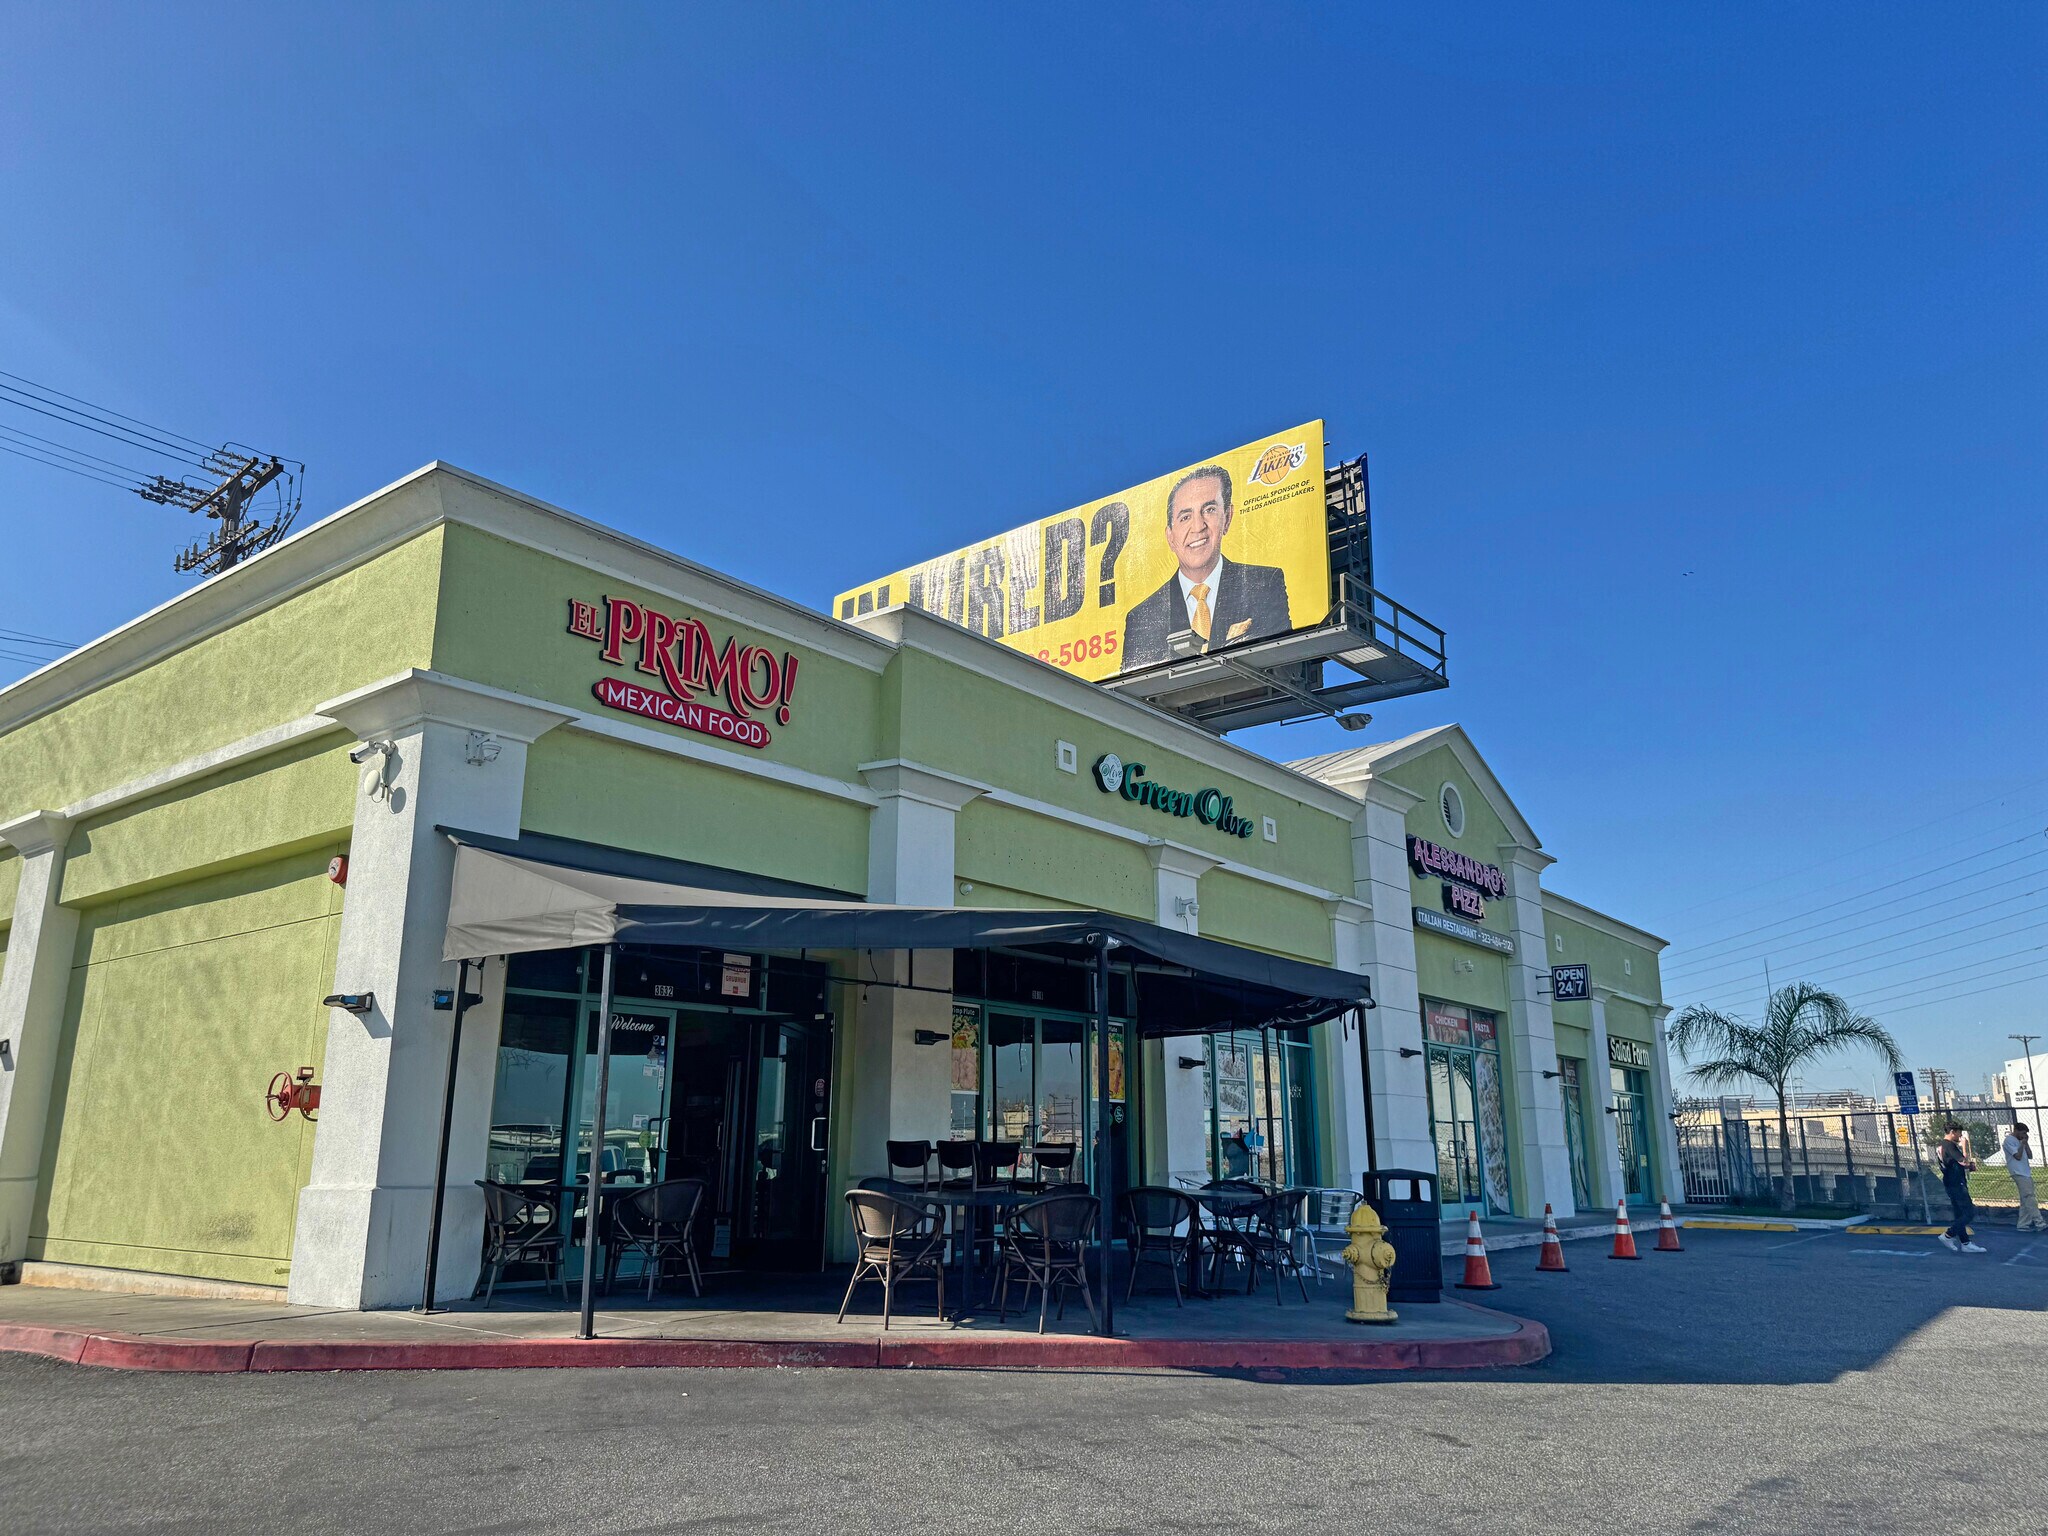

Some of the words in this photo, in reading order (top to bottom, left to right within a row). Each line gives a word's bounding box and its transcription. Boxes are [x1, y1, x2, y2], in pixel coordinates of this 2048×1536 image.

[1251, 450, 1303, 482] LAKERS
[1239, 507, 1250, 515] THE
[1251, 503, 1263, 511] LOS
[1263, 493, 1291, 507] ANGELES
[1291, 486, 1315, 498] LAKERS
[1243, 494, 1270, 506] OFFICIAL
[1270, 483, 1300, 498] SPONSOR
[1301, 479, 1311, 487] OF
[567, 598, 604, 641] EL
[600, 594, 800, 726] PRIMO!
[607, 681, 703, 728] MEXICAN
[708, 712, 763, 744] FOOD
[1122, 761, 1194, 818] Green
[1196, 788, 1255, 838] Olive
[1413, 837, 1508, 896] ALESSANDRO'S
[1451, 885, 1486, 918] PIZZA
[1418, 911, 1442, 928] ITALIAN
[1442, 920, 1477, 940] RESTAURANT
[1556, 968, 1584, 981] OPEN
[1558, 980, 1584, 996] 24/7
[654, 985, 674, 997] 3632
[611, 1014, 655, 1032] Welcome
[1434, 1015, 1458, 1028] CHICKEN
[1474, 1022, 1490, 1034] PASTA
[1610, 1036, 1632, 1063] Salad
[1632, 1042, 1650, 1066] Farm
